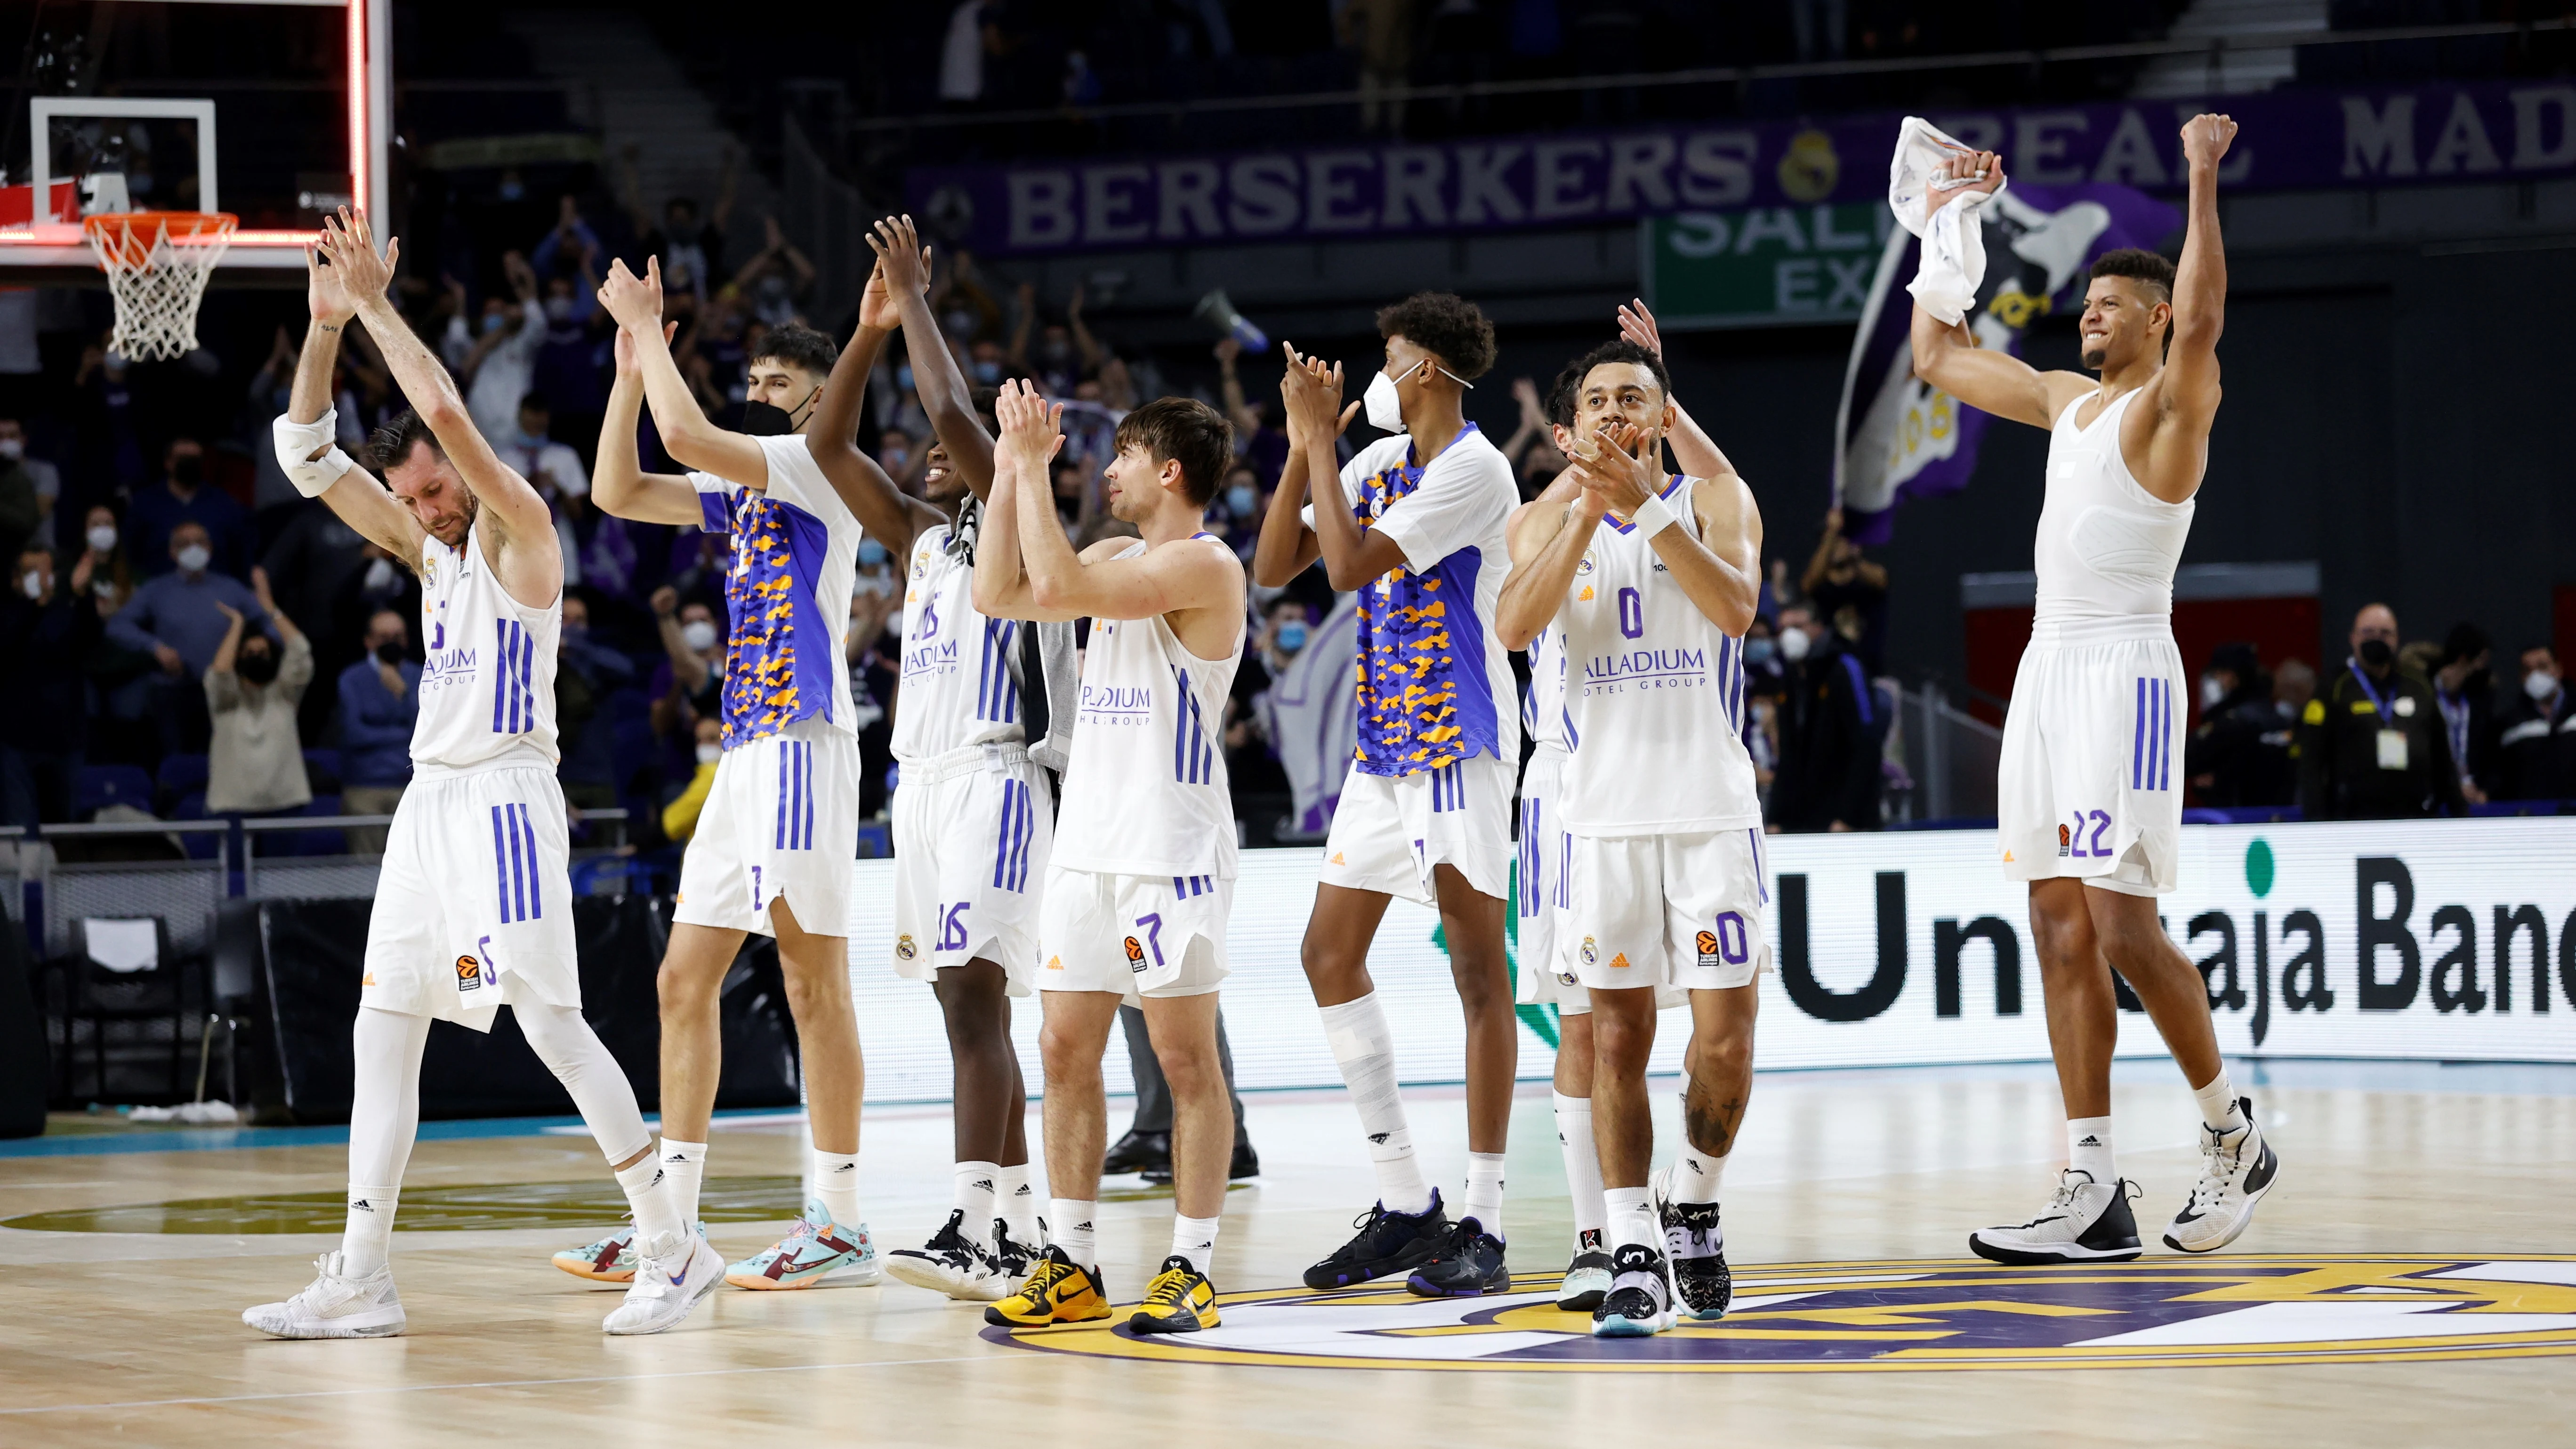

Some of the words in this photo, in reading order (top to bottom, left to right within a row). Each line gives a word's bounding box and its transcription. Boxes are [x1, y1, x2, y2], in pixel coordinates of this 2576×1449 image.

[1006, 131, 1758, 248] BERSERKERS
[1618, 587, 1643, 640] 0
[1640, 677, 1706, 690] GROUP
[2071, 809, 2113, 857] 22
[751, 865, 762, 911] 1
[935, 902, 970, 951] 16
[1135, 912, 1165, 967] 7
[1715, 910, 1749, 965] 0
[479, 934, 497, 986] 5
[972, 1183, 995, 1195] adidas
